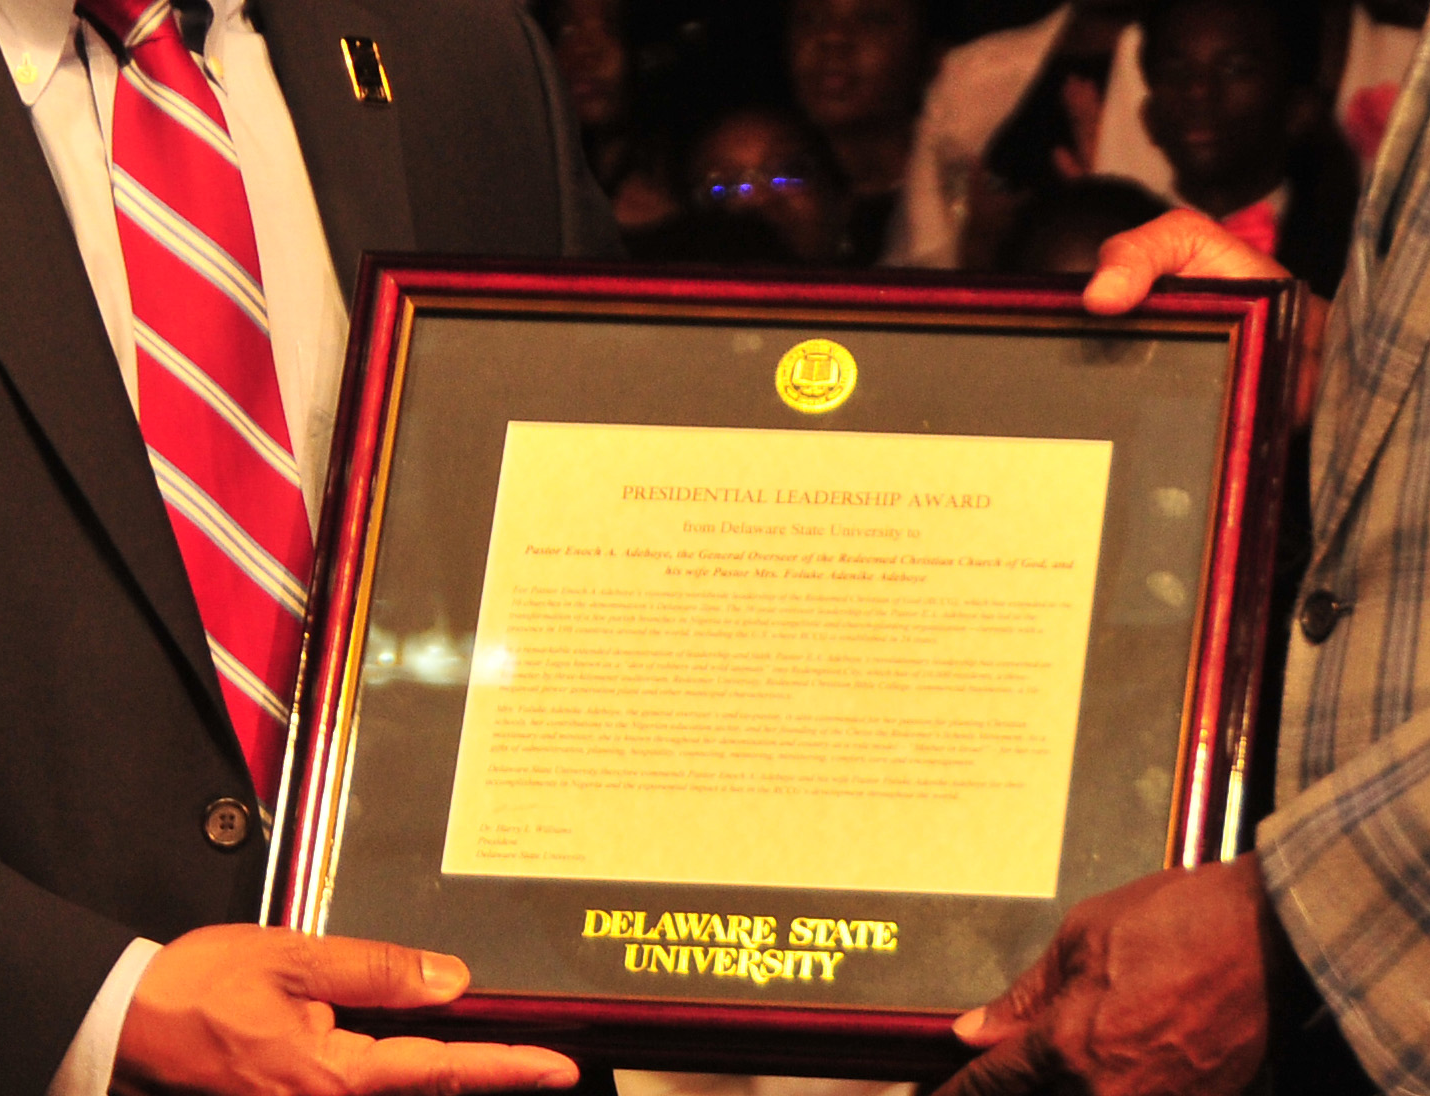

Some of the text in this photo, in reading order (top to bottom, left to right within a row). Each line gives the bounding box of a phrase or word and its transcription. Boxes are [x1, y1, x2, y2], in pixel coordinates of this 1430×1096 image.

[621, 484, 992, 512] PRESIDENTIAL LEADERSHIP AWARD
[682, 520, 920, 542] from Delaware State University to
[524, 544, 561, 554] Pastor
[564, 545, 601, 556] Enoch
[676, 549, 694, 559] the
[698, 550, 744, 561] General
[747, 551, 798, 563] Overseer
[800, 553, 813, 566] of
[816, 554, 834, 564] the
[838, 555, 896, 566] Redeemed
[899, 557, 954, 568] Christian
[957, 559, 1001, 570] Church
[1006, 560, 1017, 573] of
[1050, 562, 1073, 572] and
[581, 909, 899, 950] DELAWARE STATE
[623, 943, 844, 985] UNIVERSITY
